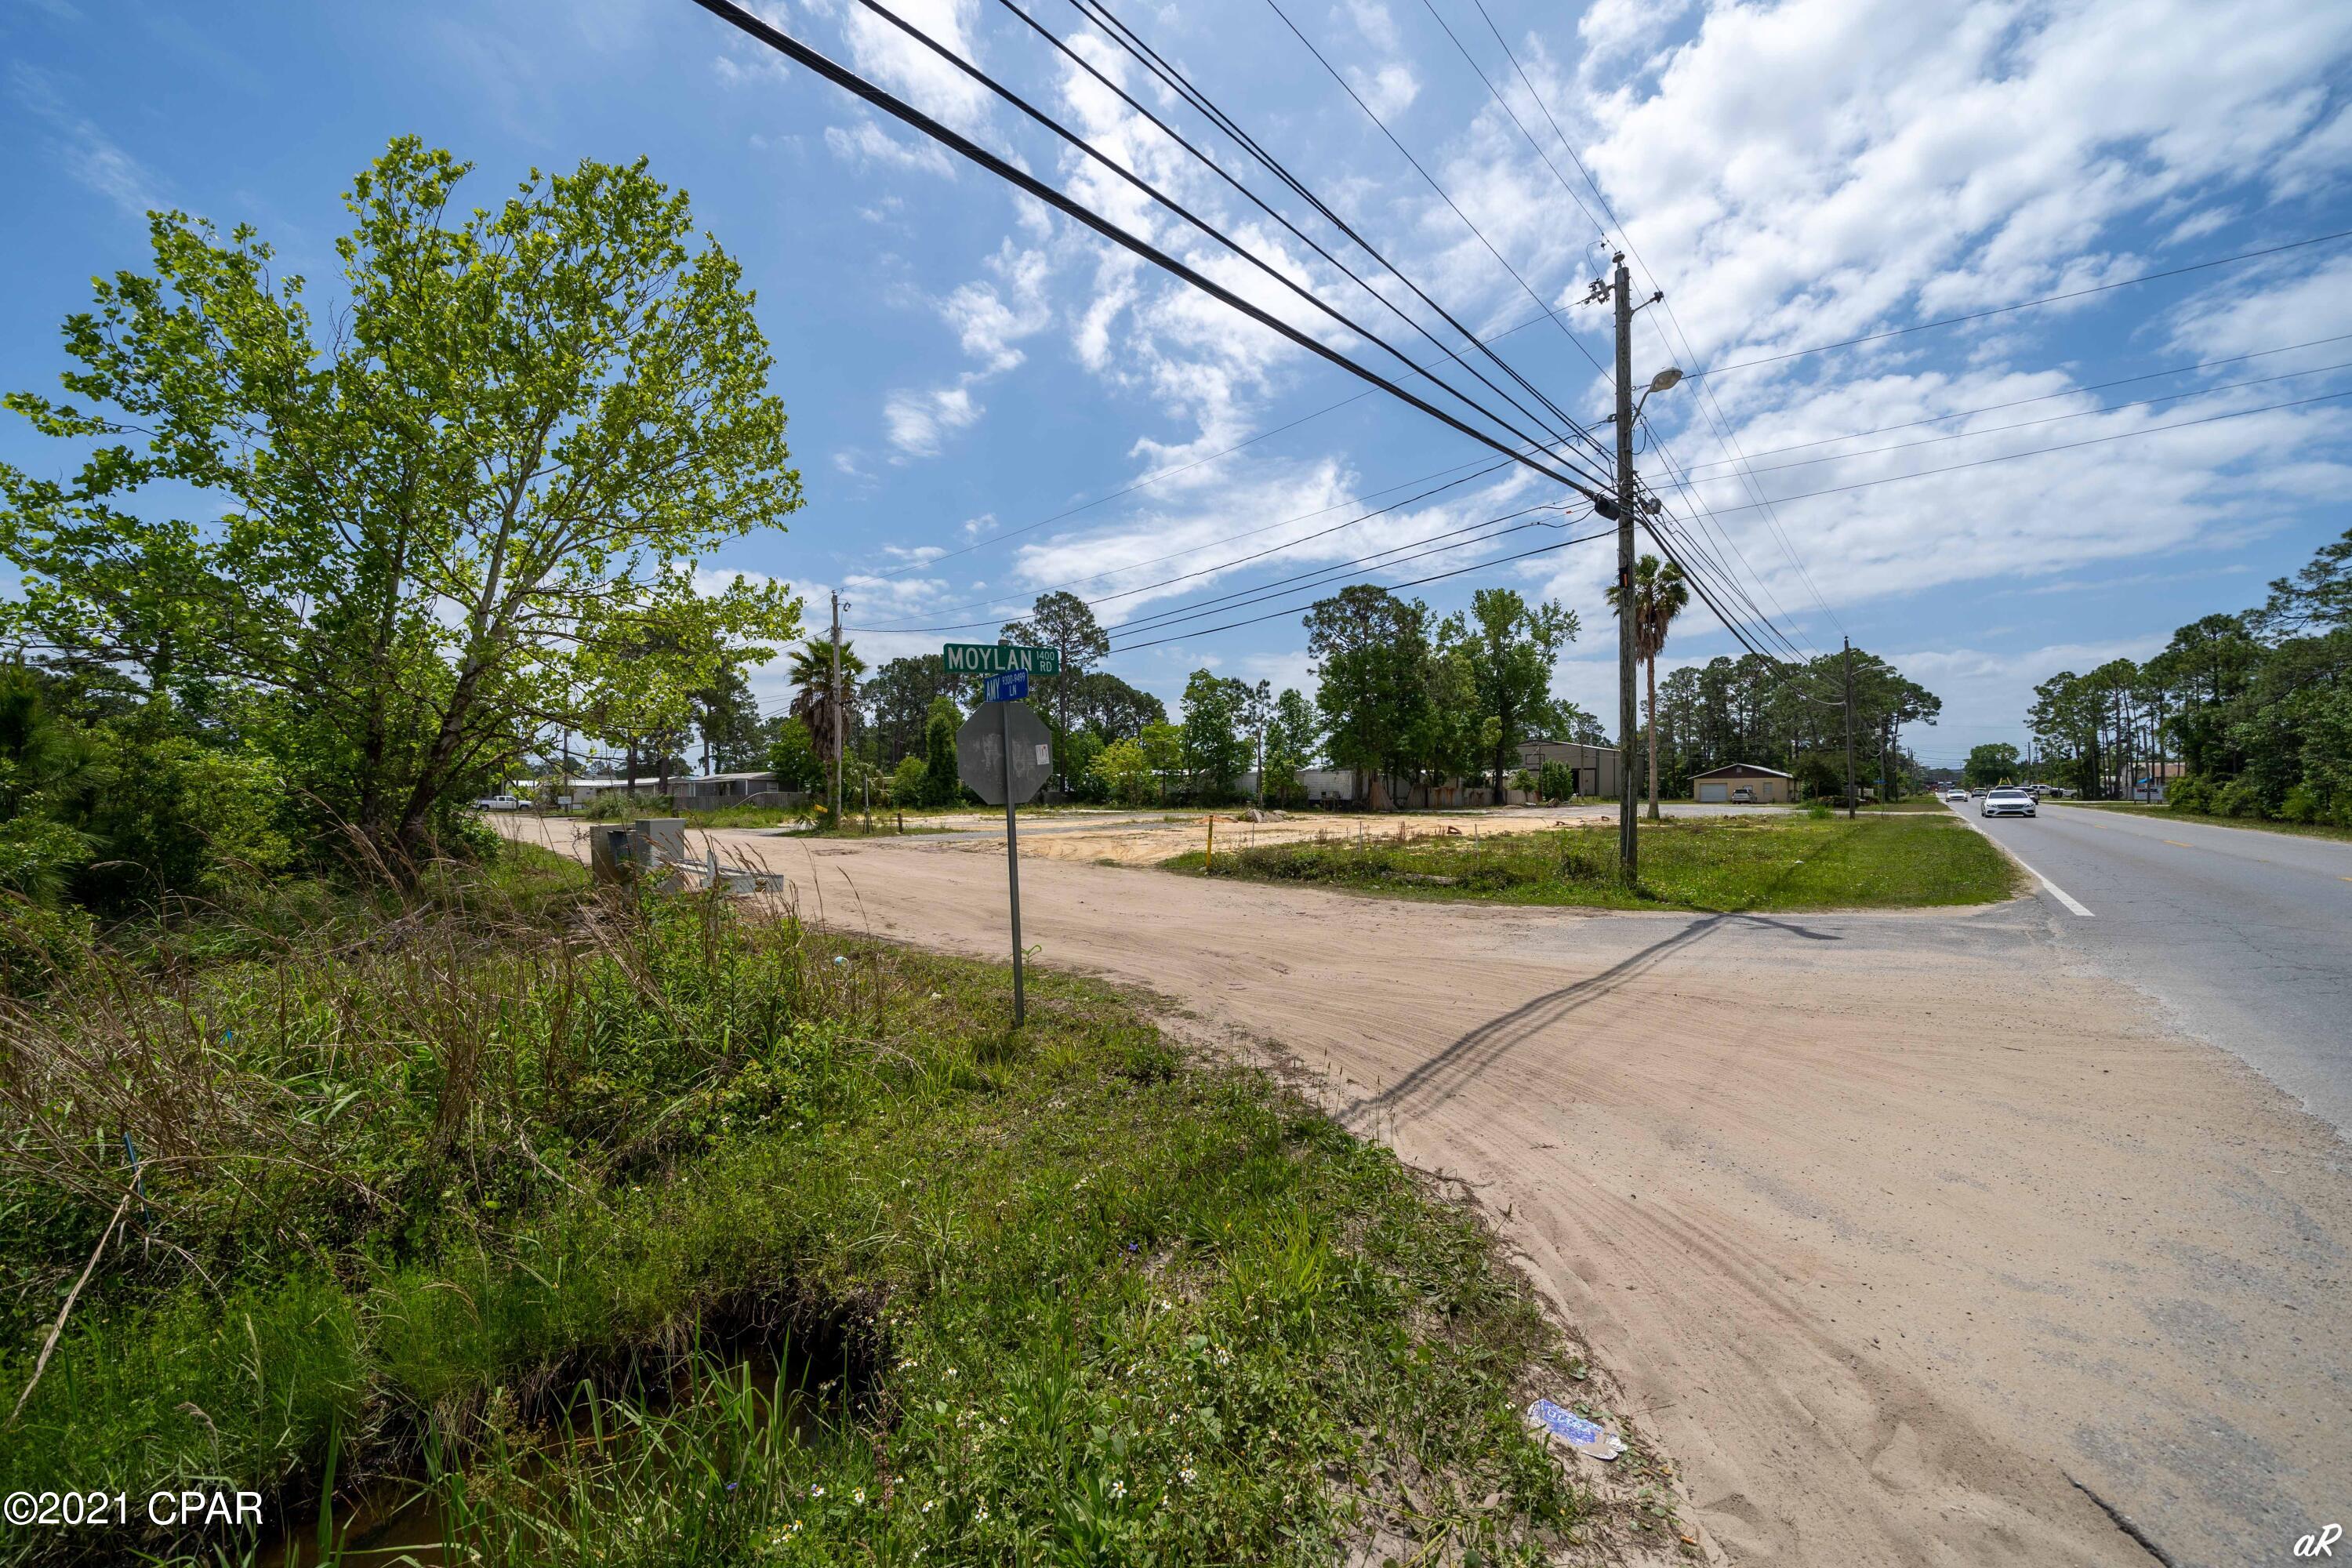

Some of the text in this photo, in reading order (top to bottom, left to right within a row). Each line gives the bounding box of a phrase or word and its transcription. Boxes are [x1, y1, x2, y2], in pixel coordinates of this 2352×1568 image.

[948, 647, 1032, 671] MOYLAN
[1036, 651, 1054, 661] 1400
[1040, 661, 1052, 672] RD
[1002, 672, 1025, 684] 9300-9499
[986, 677, 1000, 702] AMY
[1009, 684, 1017, 696] LN
